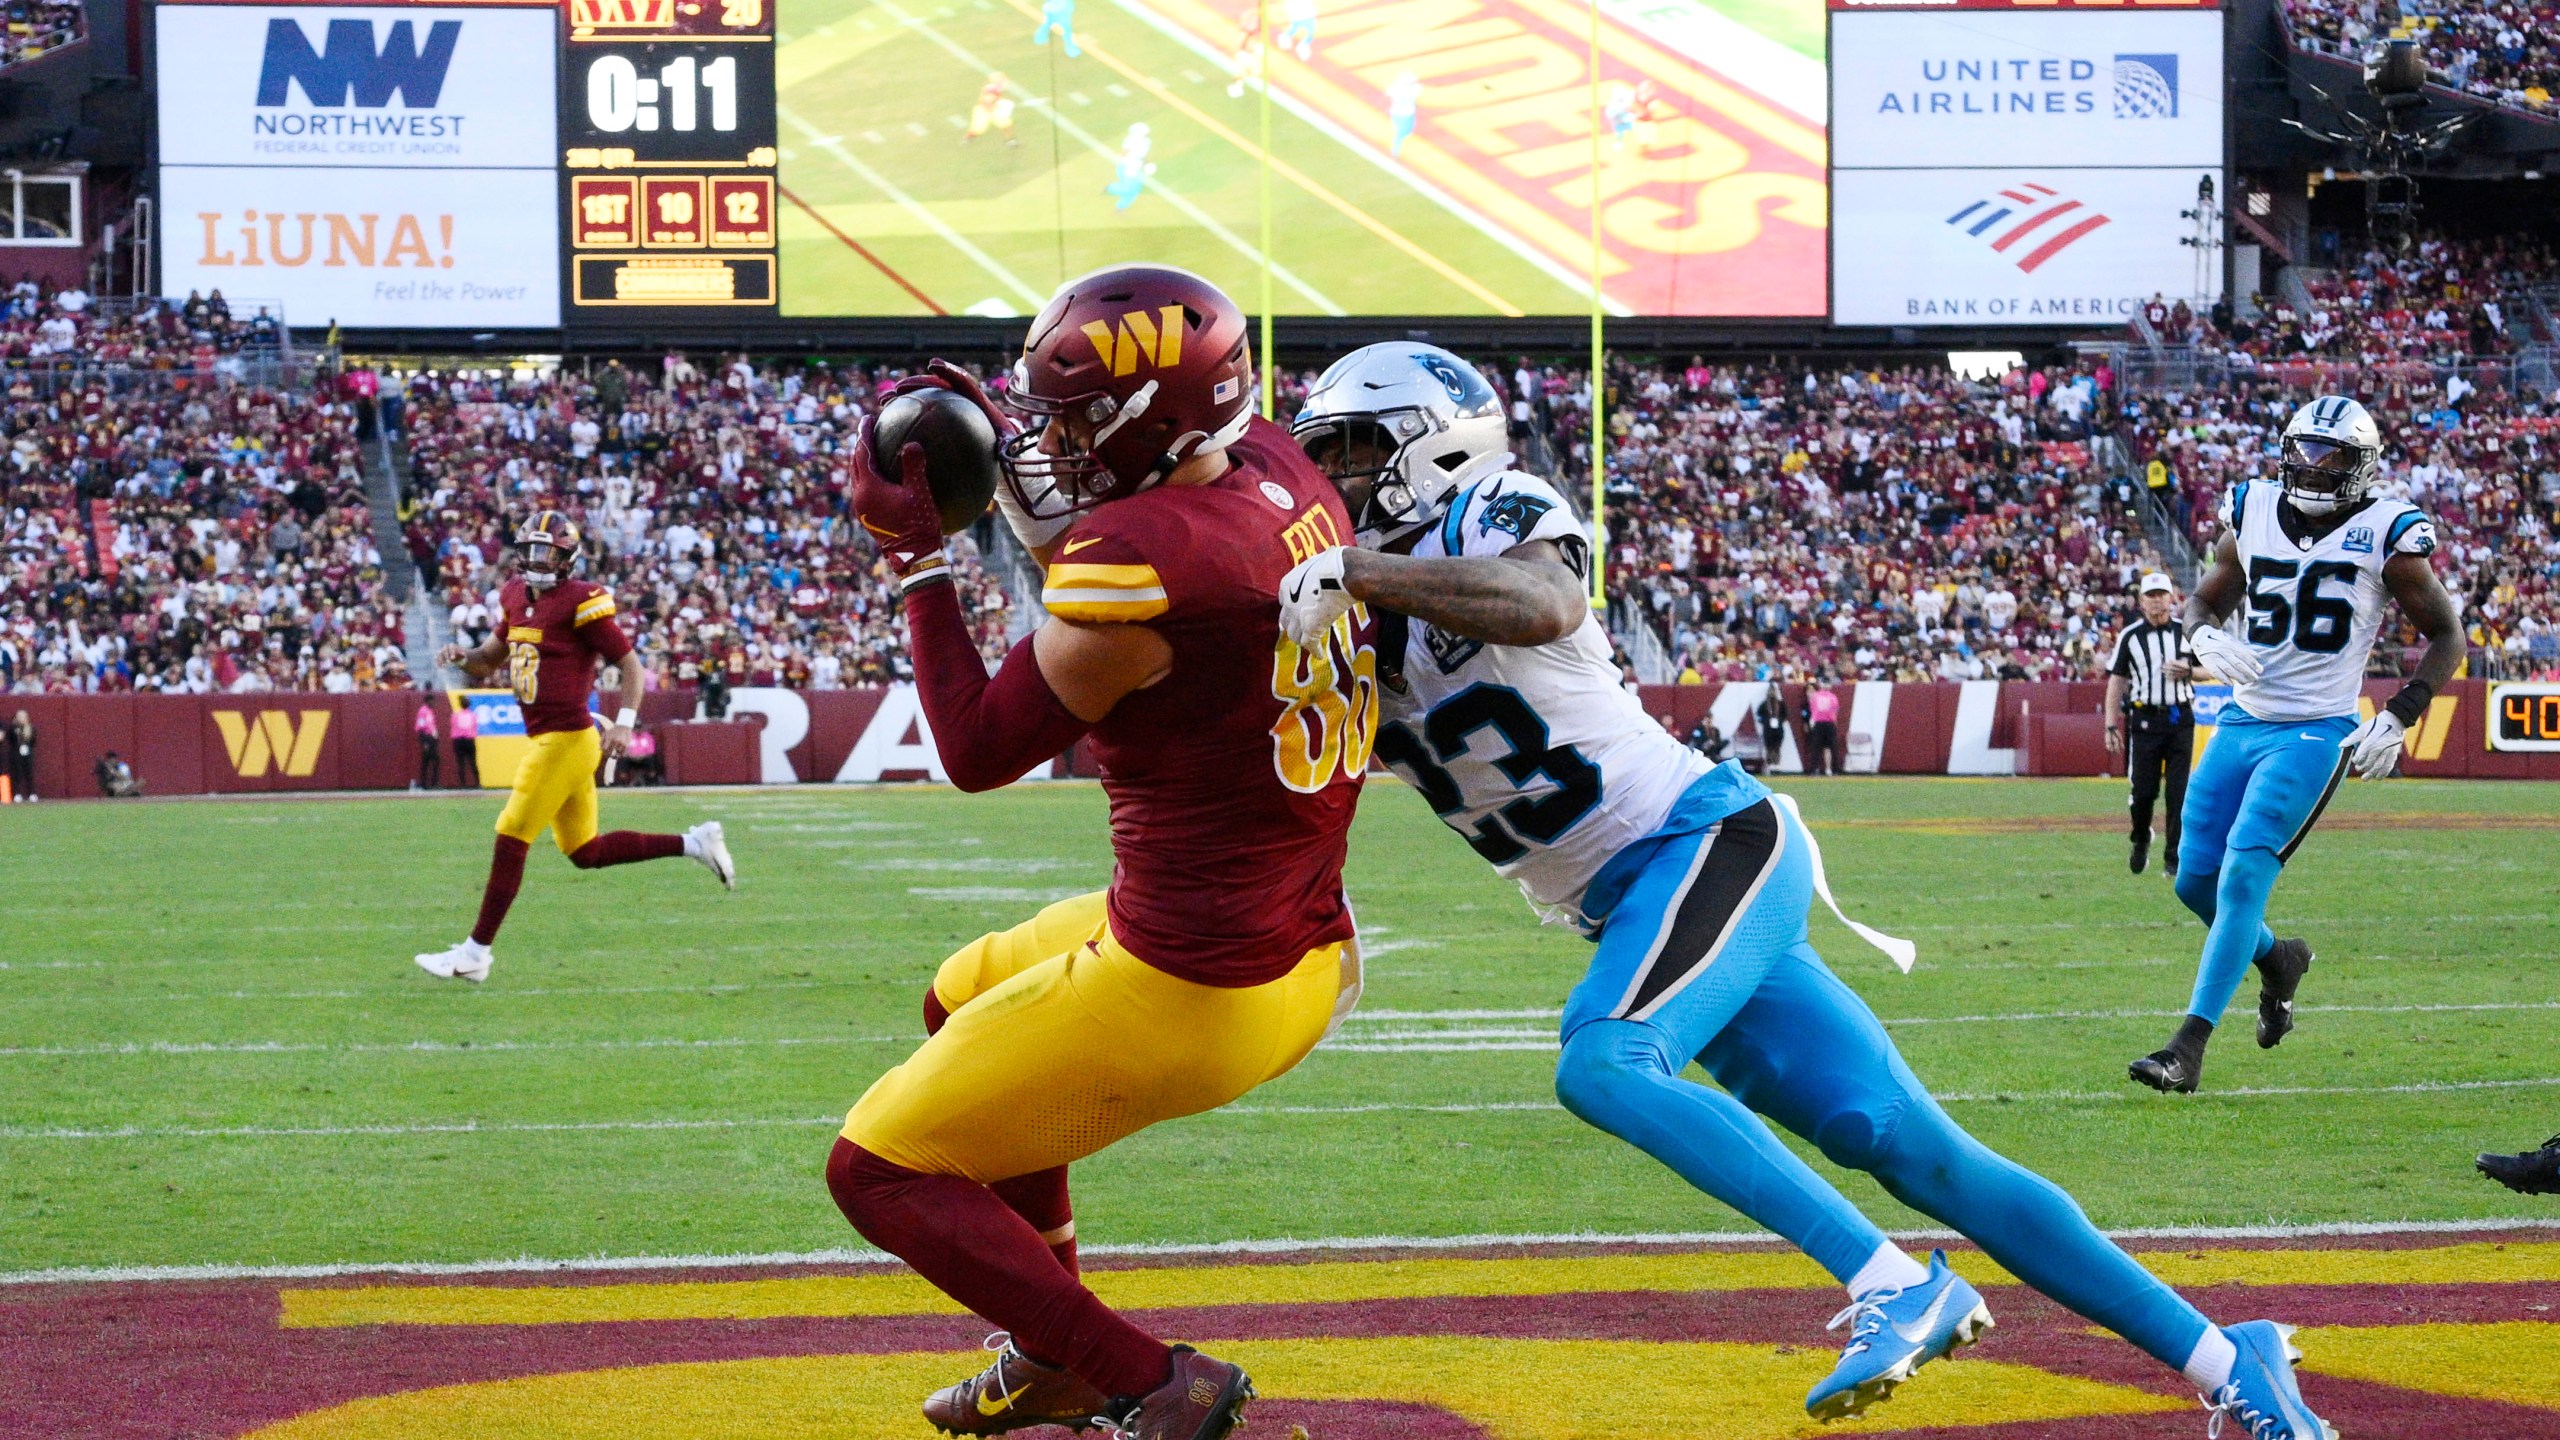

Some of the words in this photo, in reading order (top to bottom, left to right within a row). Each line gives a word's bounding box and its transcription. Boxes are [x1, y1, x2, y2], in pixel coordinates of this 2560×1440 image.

[256, 18, 463, 108] NW
[1922, 59, 2096, 82] UNITED
[587, 55, 737, 132] 0:11
[1878, 92, 2096, 114] AIRLINES
[254, 114, 465, 137] NORTHWEST
[253, 140, 329, 154] FEDERAL
[335, 141, 395, 154] CREDIT
[401, 141, 461, 155] UNION
[581, 194, 630, 224] 1ST
[656, 192, 694, 224] 10
[723, 192, 760, 224] 12
[197, 208, 455, 268] LiUNA!
[373, 281, 415, 301] Feel
[421, 281, 455, 301] the
[460, 282, 527, 301] Power
[1906, 298, 1979, 315] BANK
[1988, 298, 2020, 315] OF
[2028, 298, 2141, 315] AMERIC
[1080, 304, 1183, 377] W
[2346, 527, 2374, 545] 30
[2247, 554, 2359, 655] 56
[1269, 600, 1379, 793] 86
[2506, 697, 2560, 740] 40
[212, 710, 331, 777] W
[1373, 680, 1603, 867] 23
